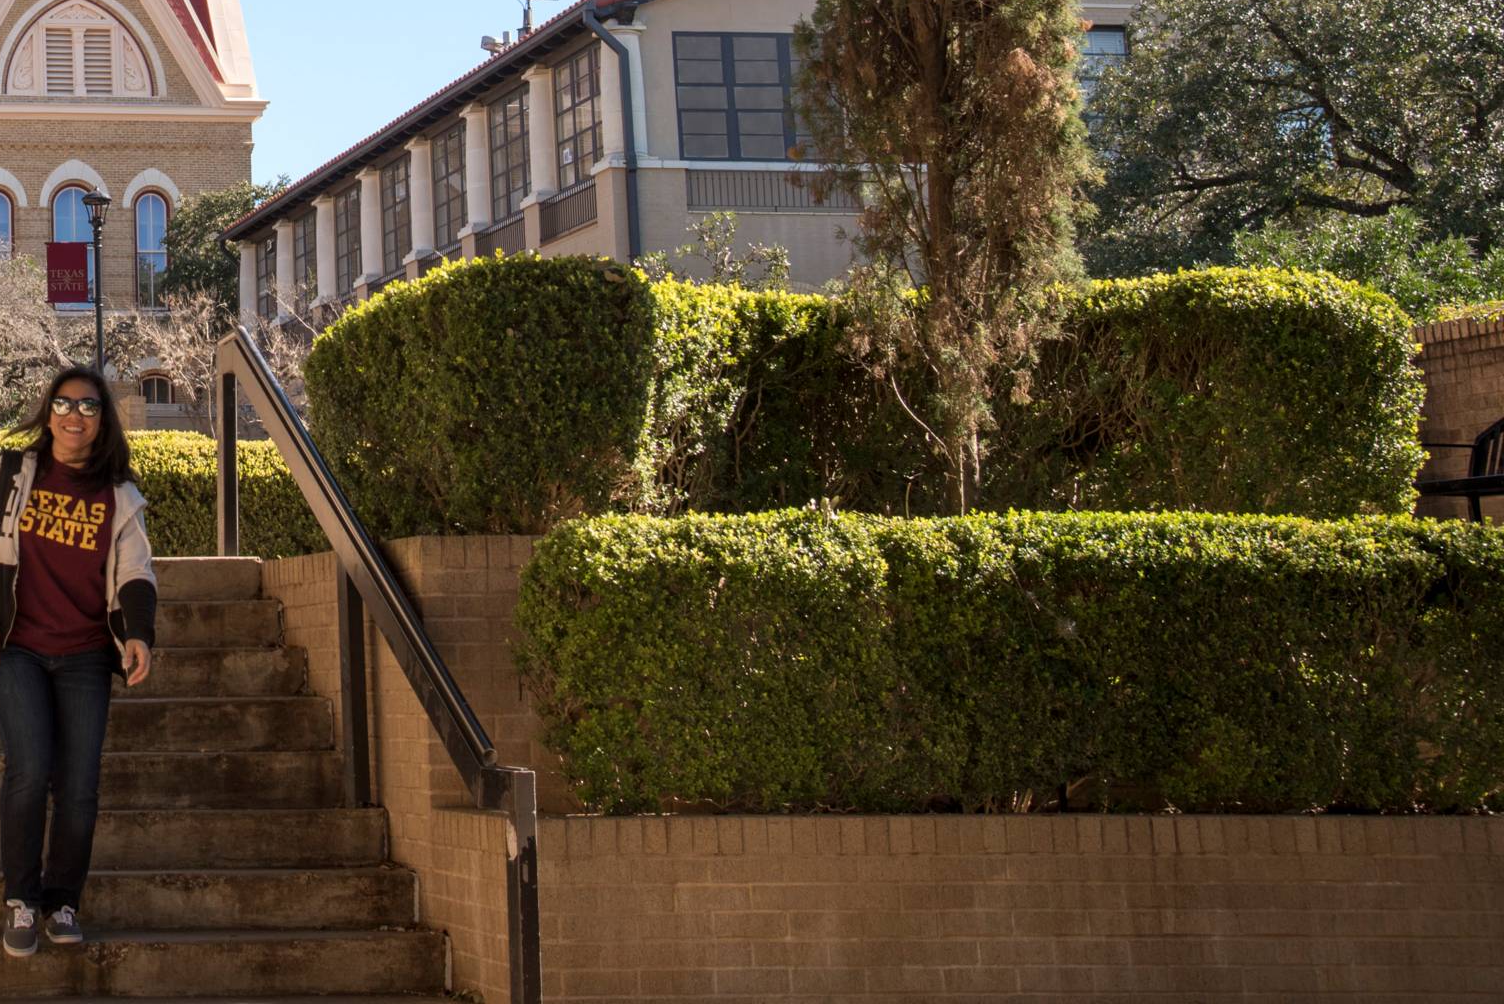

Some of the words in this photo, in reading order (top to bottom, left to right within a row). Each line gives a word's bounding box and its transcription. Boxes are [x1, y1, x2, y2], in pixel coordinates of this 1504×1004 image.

[49, 269, 84, 278] TEXAS
[50, 282, 84, 292] STATE
[19, 507, 98, 550] STATE
